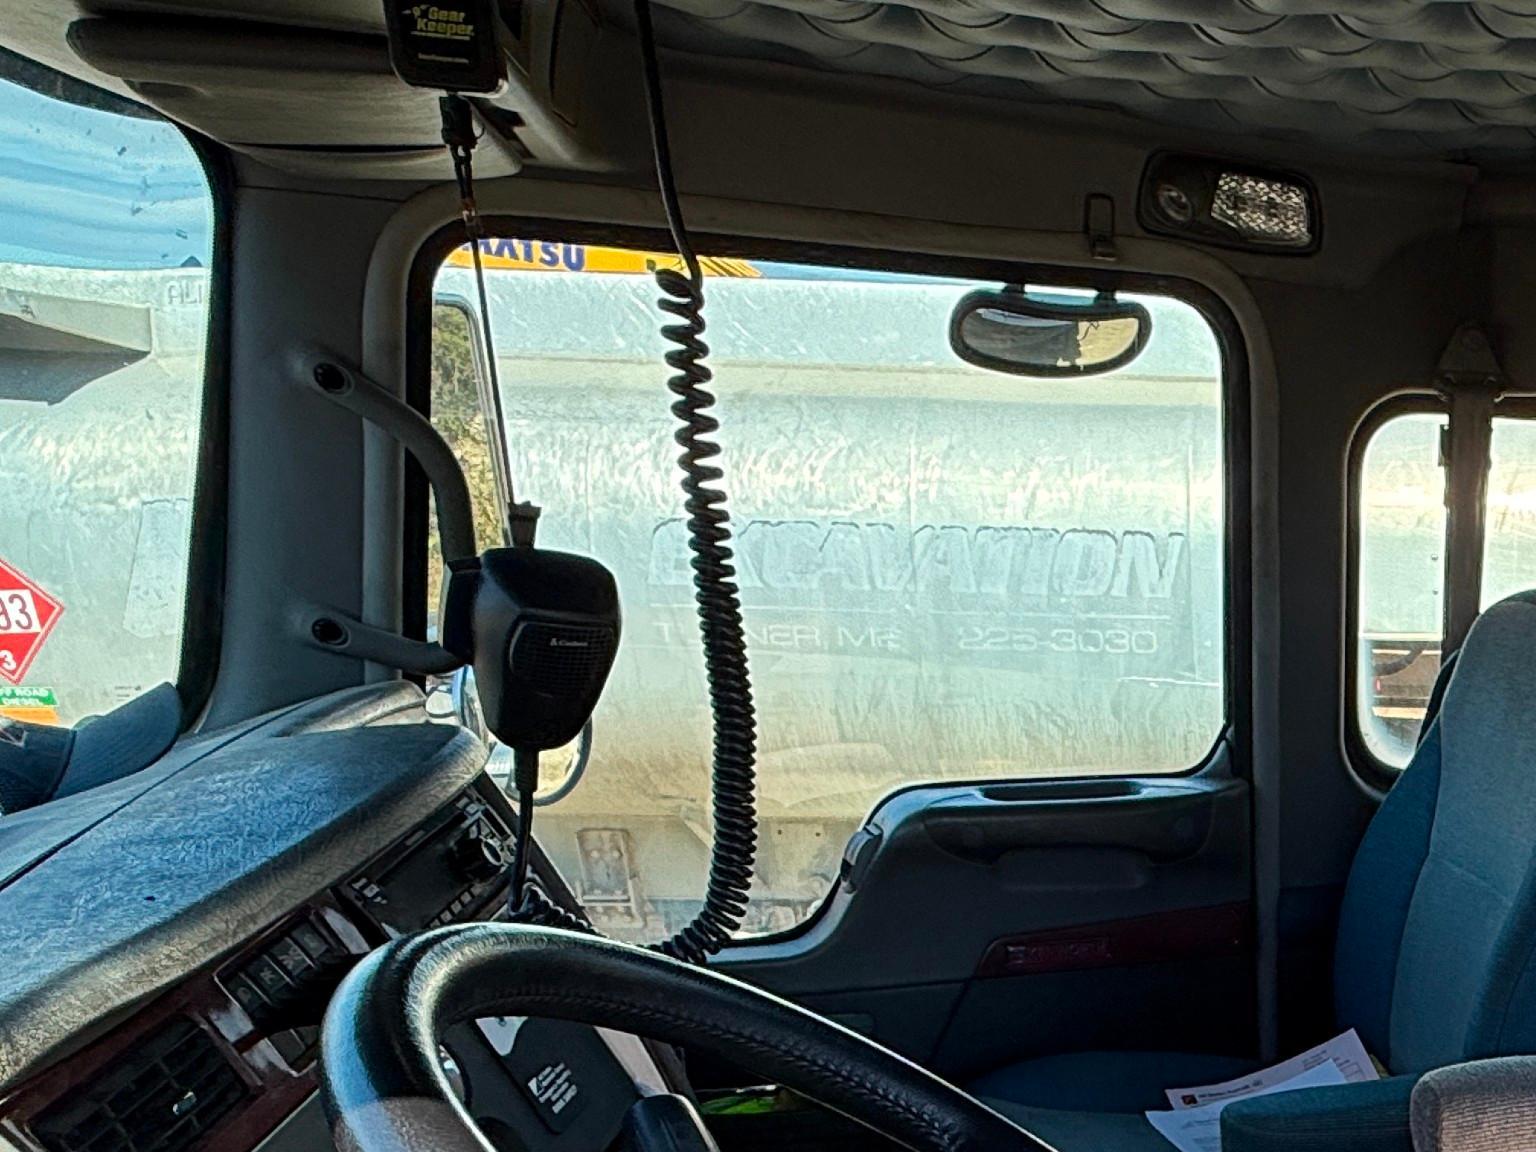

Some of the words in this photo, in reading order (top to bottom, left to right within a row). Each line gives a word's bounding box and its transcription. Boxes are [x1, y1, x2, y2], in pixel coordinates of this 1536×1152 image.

[428, 6, 466, 22] Gear
[416, 18, 475, 37] Keeper
[653, 622, 827, 648] TNER,
[959, 626, 1157, 653] 225-3030
